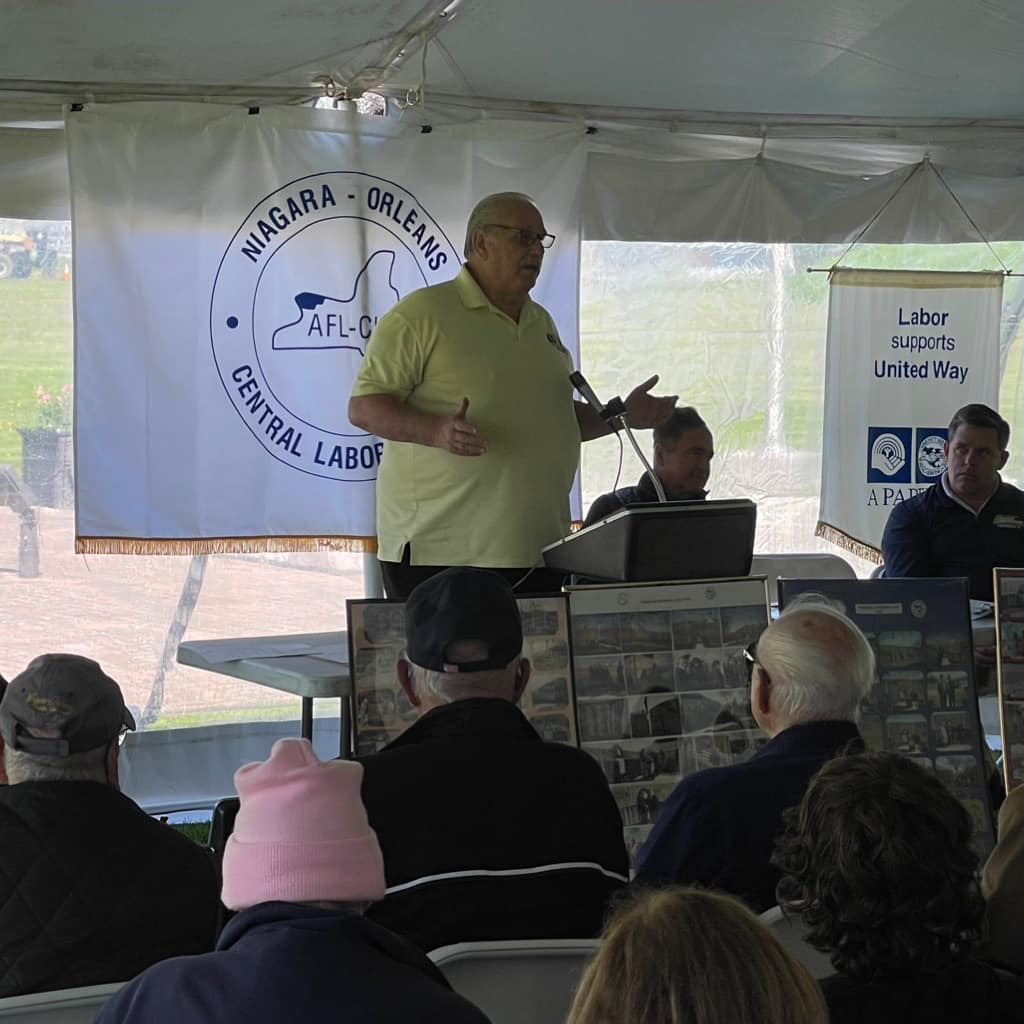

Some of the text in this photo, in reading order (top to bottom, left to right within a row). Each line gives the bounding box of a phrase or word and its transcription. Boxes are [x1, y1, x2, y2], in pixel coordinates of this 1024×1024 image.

[241, 184, 336, 263] NIAGARA
[367, 187, 447, 271] ORLEANS
[308, 314, 377, 338] AFL-C
[898, 308, 949, 326] Labor
[892, 335, 955, 352] supports
[875, 360, 968, 384] United Way
[232, 364, 302, 457] CENTRAL
[868, 489, 878, 506] A
